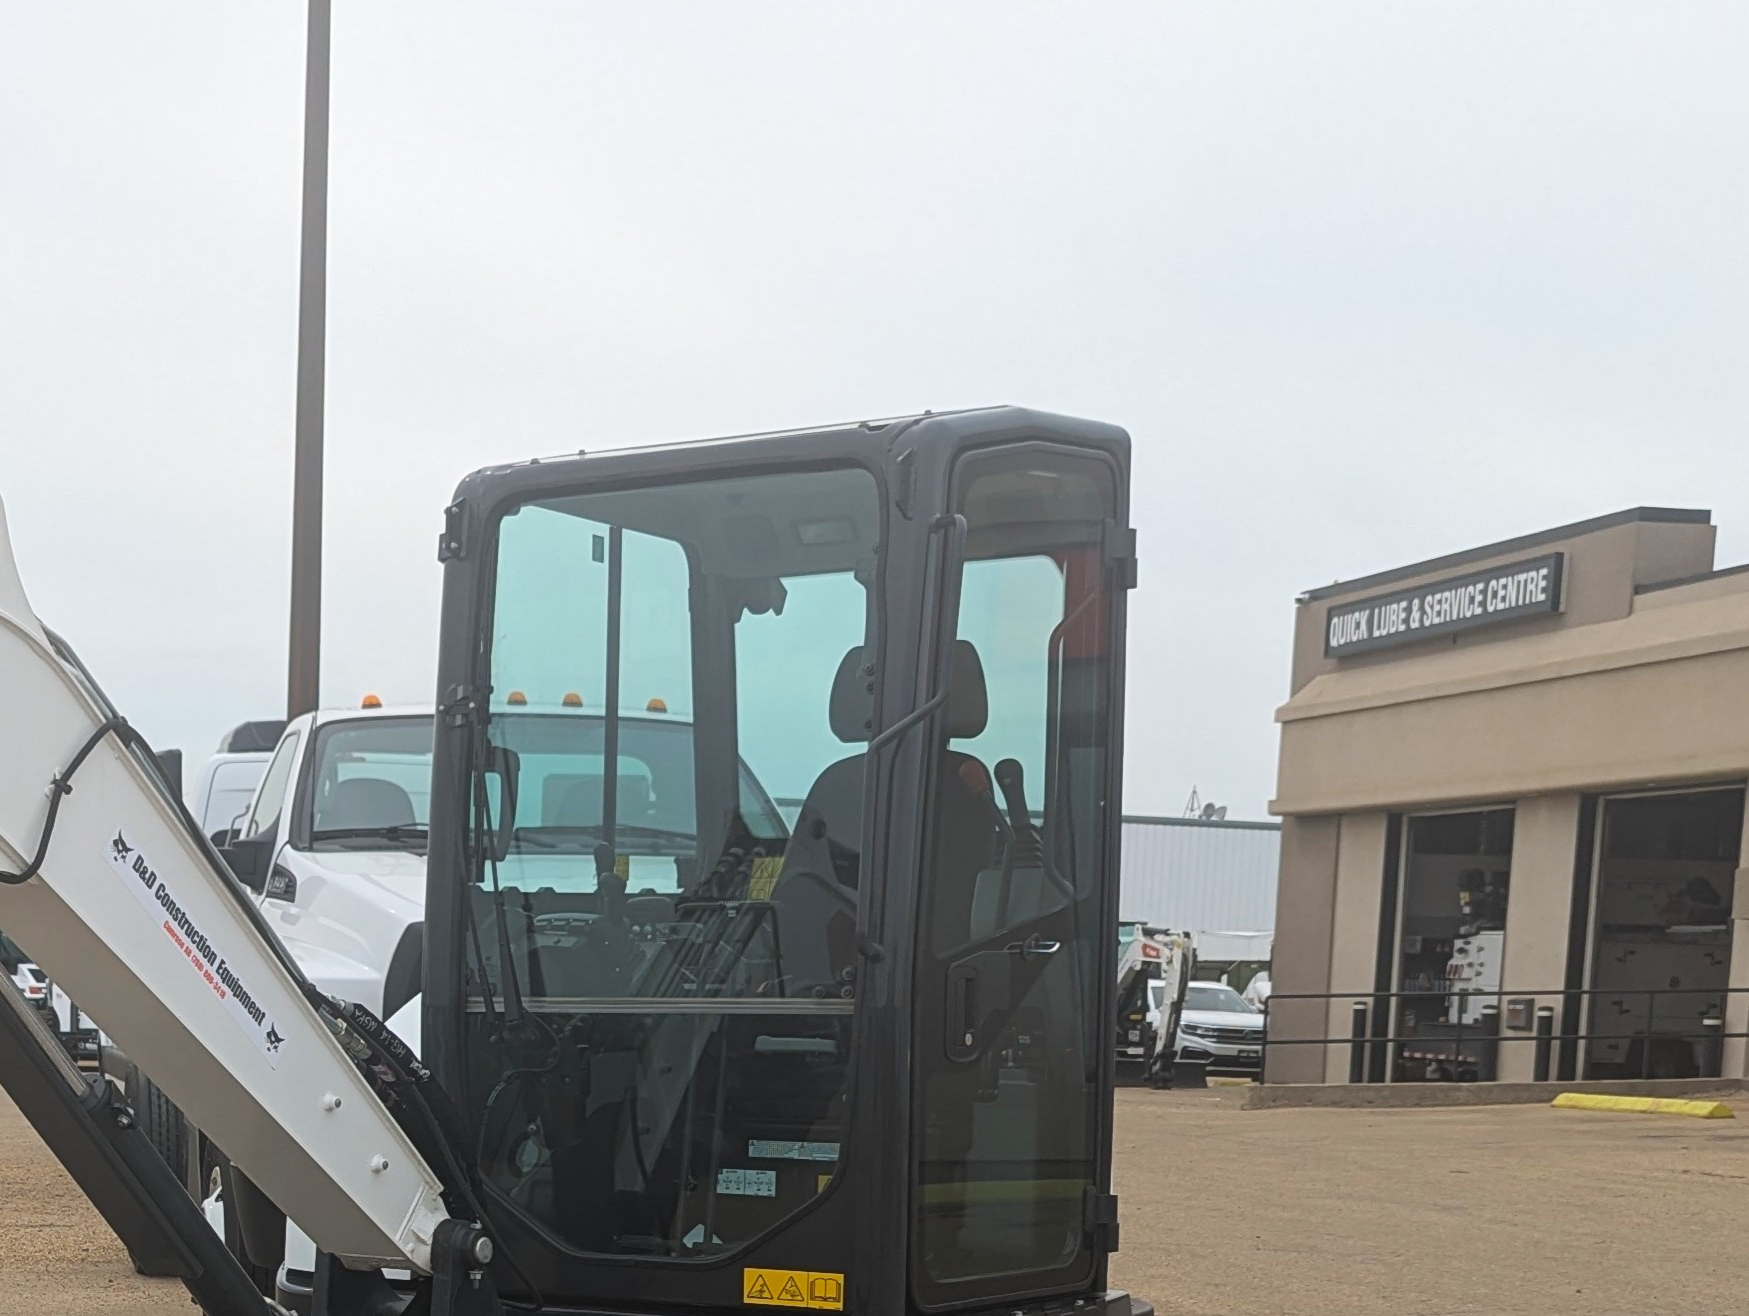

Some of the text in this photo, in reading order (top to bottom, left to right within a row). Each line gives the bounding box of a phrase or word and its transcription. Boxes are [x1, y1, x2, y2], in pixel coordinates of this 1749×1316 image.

[1329, 567, 1549, 648] QUICK LUBE & SERVICE CENTRE
[131, 853, 266, 1027] D&D Construction Equipment
